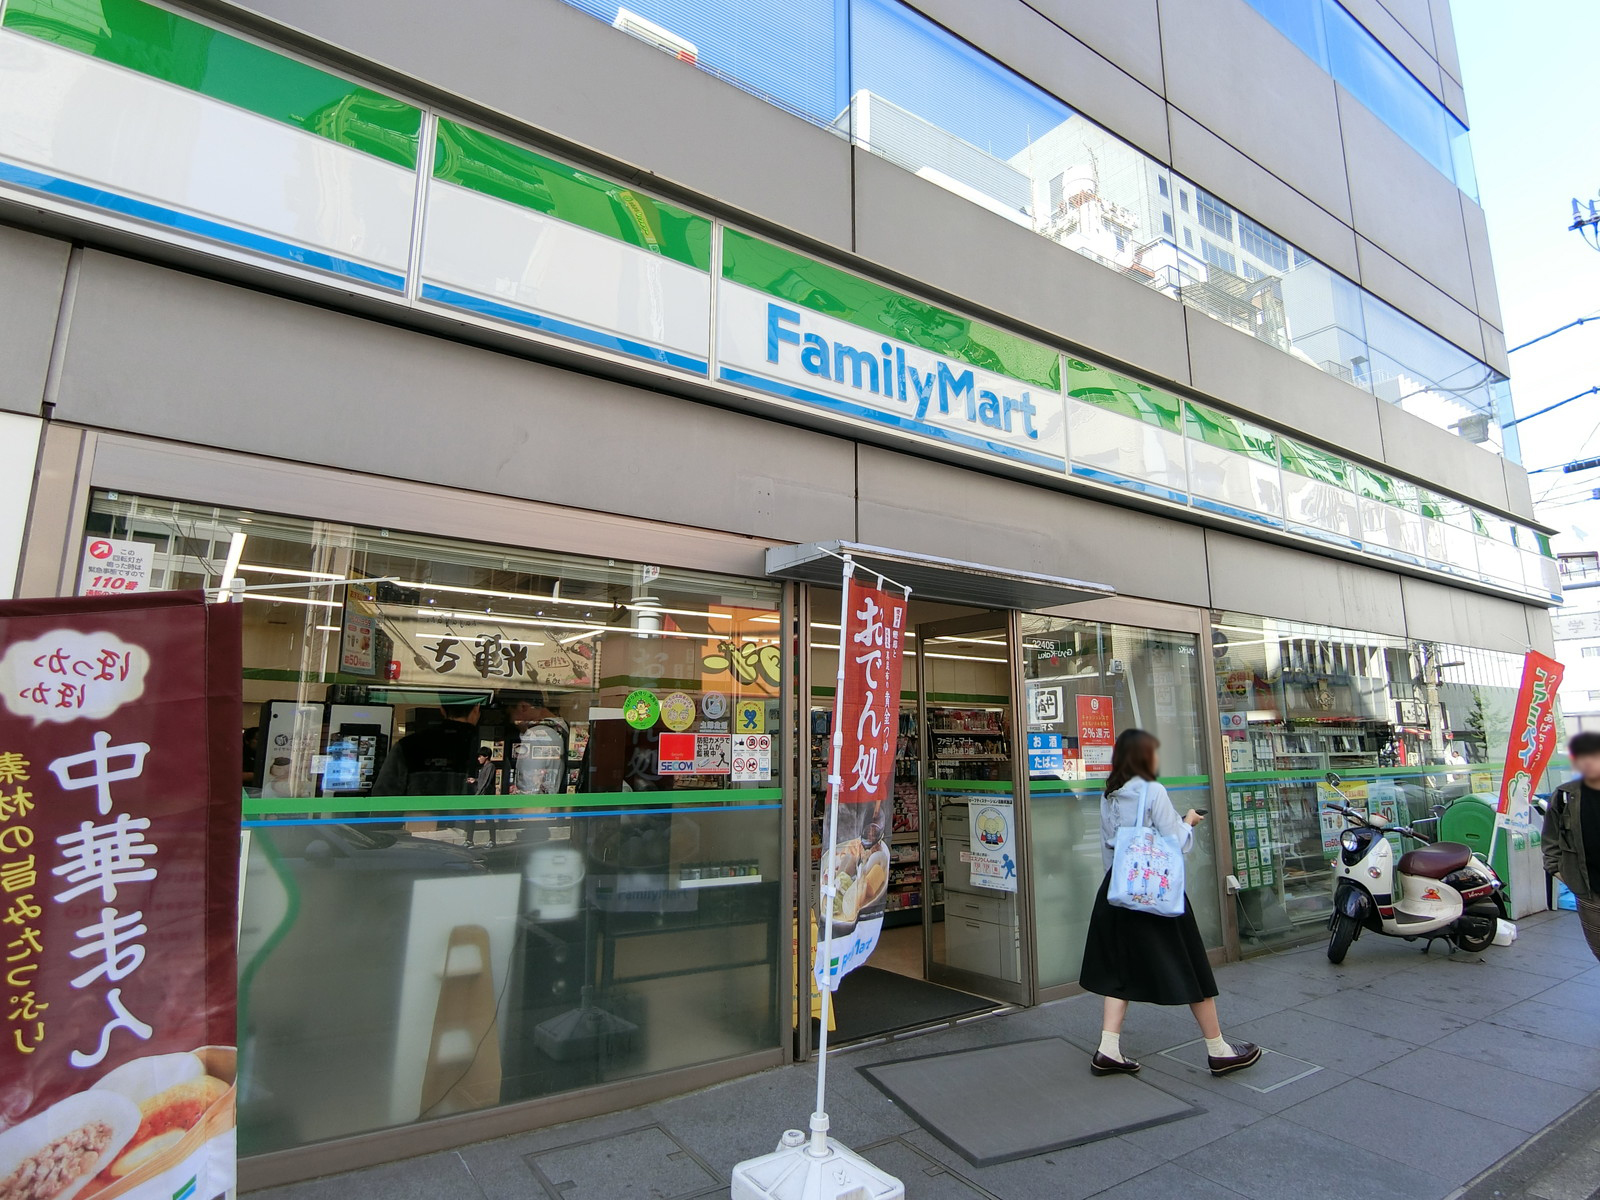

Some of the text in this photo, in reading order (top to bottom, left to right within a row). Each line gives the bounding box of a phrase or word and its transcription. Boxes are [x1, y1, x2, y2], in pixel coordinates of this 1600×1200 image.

[765, 301, 1038, 439] FamilyMart
[92, 576, 138, 590] 110番
[849, 596, 884, 794] おでん処
[1518, 667, 1548, 769] ファミペイ
[1082, 727, 1110, 739] 2%還元
[696, 736, 730, 745] 防犯カメラで
[937, 737, 974, 745] ファミリーマート
[696, 750, 717, 758] 監視中
[661, 761, 693, 771] SECOM
[1034, 756, 1058, 769] たばこ
